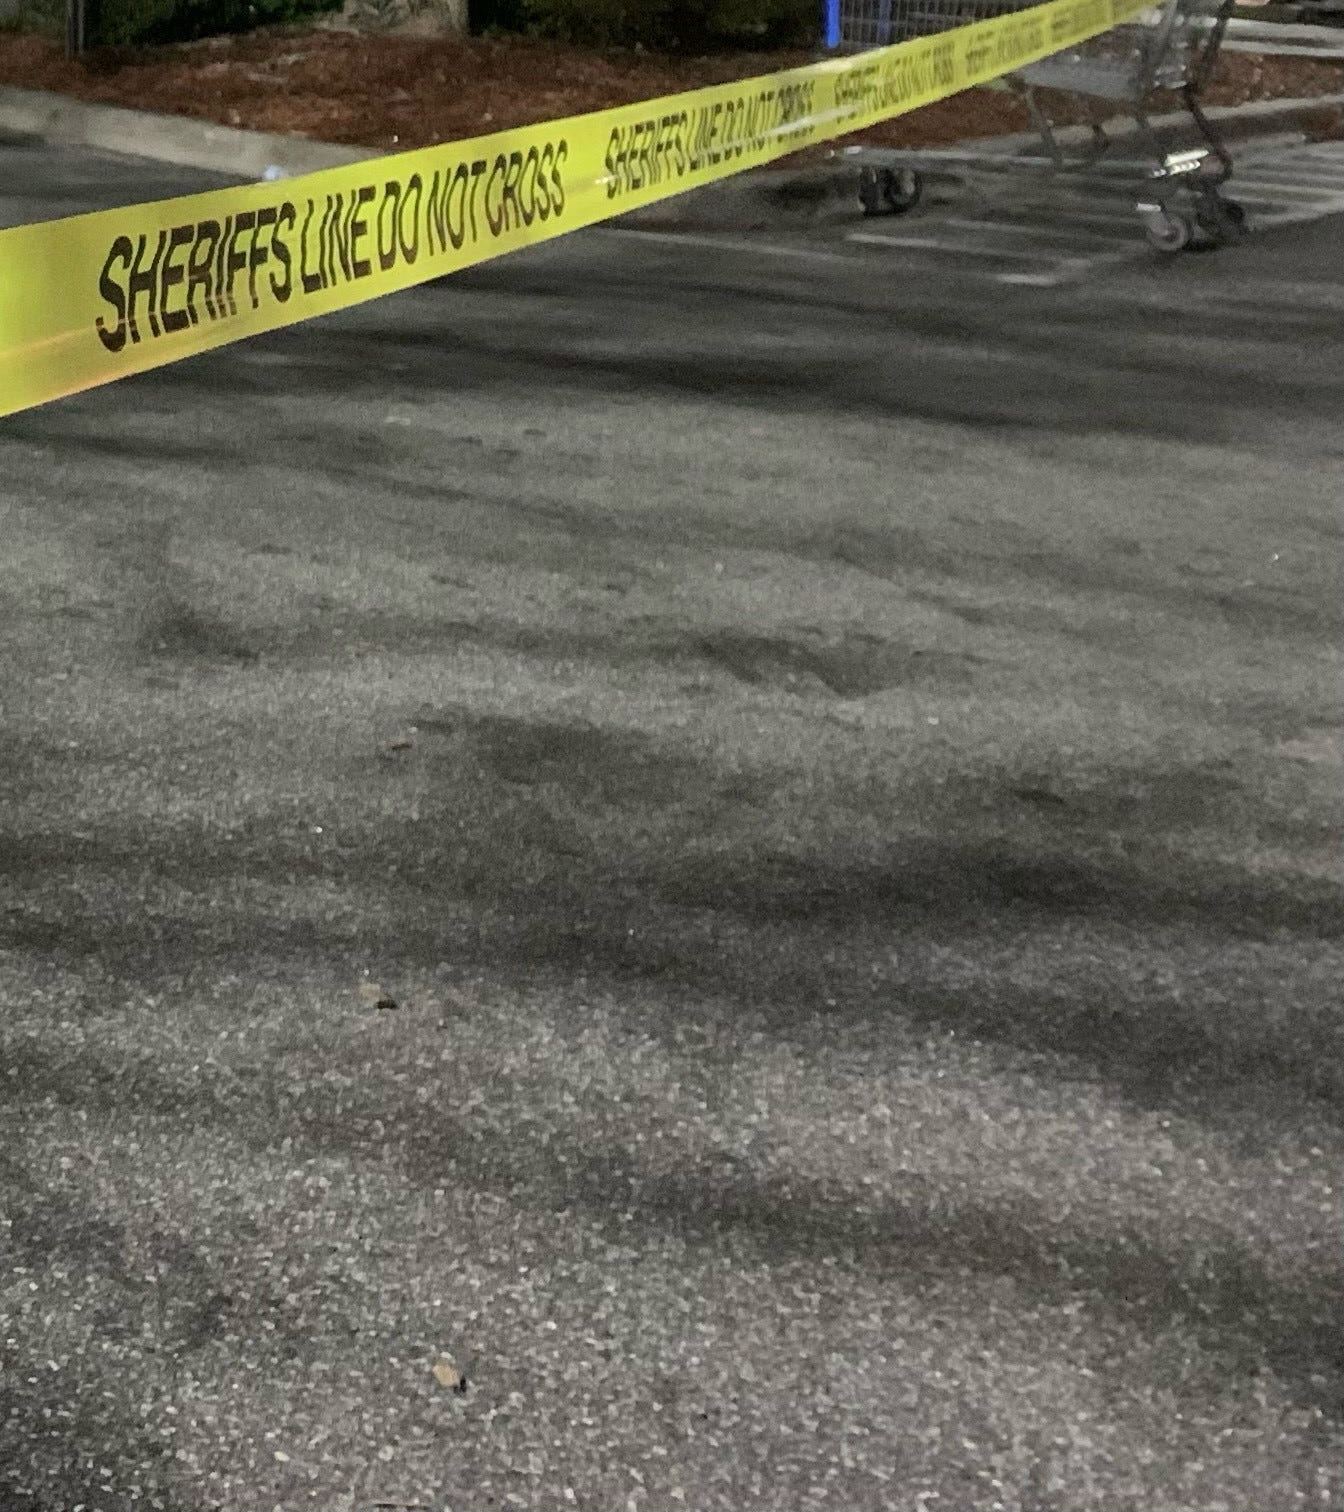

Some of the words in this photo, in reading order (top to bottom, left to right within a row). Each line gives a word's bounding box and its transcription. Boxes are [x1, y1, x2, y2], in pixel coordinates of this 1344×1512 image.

[605, 110, 688, 199] SHERIFFS
[687, 101, 723, 171] LINE
[95, 202, 296, 353] SHERIFFS
[300, 186, 376, 295] LINE
[378, 173, 422, 272] DO
[427, 161, 486, 256] NOT
[484, 139, 568, 238] CROSS
